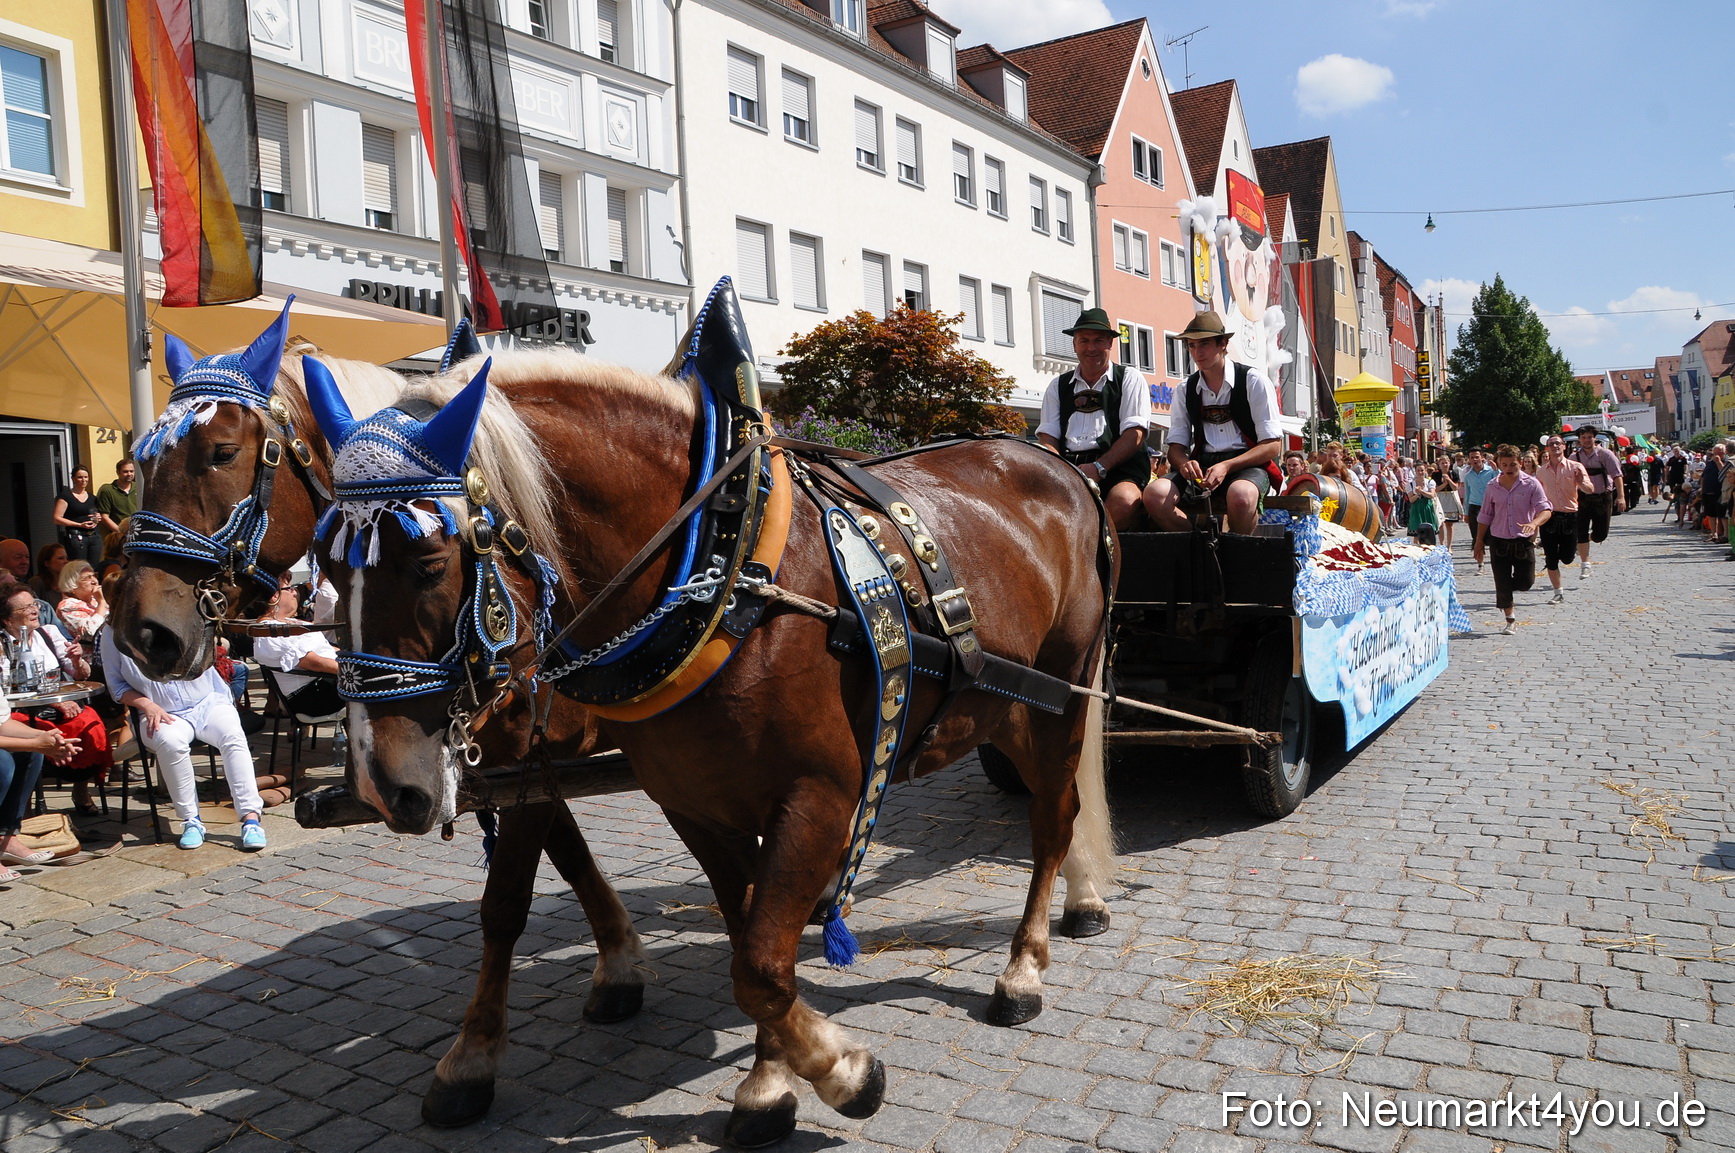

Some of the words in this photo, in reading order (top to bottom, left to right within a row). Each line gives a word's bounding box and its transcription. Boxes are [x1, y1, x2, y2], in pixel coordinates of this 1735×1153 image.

[501, 299, 597, 345] WEBER
[1417, 352, 1430, 415] HOTEL
[96, 427, 117, 444] 24
